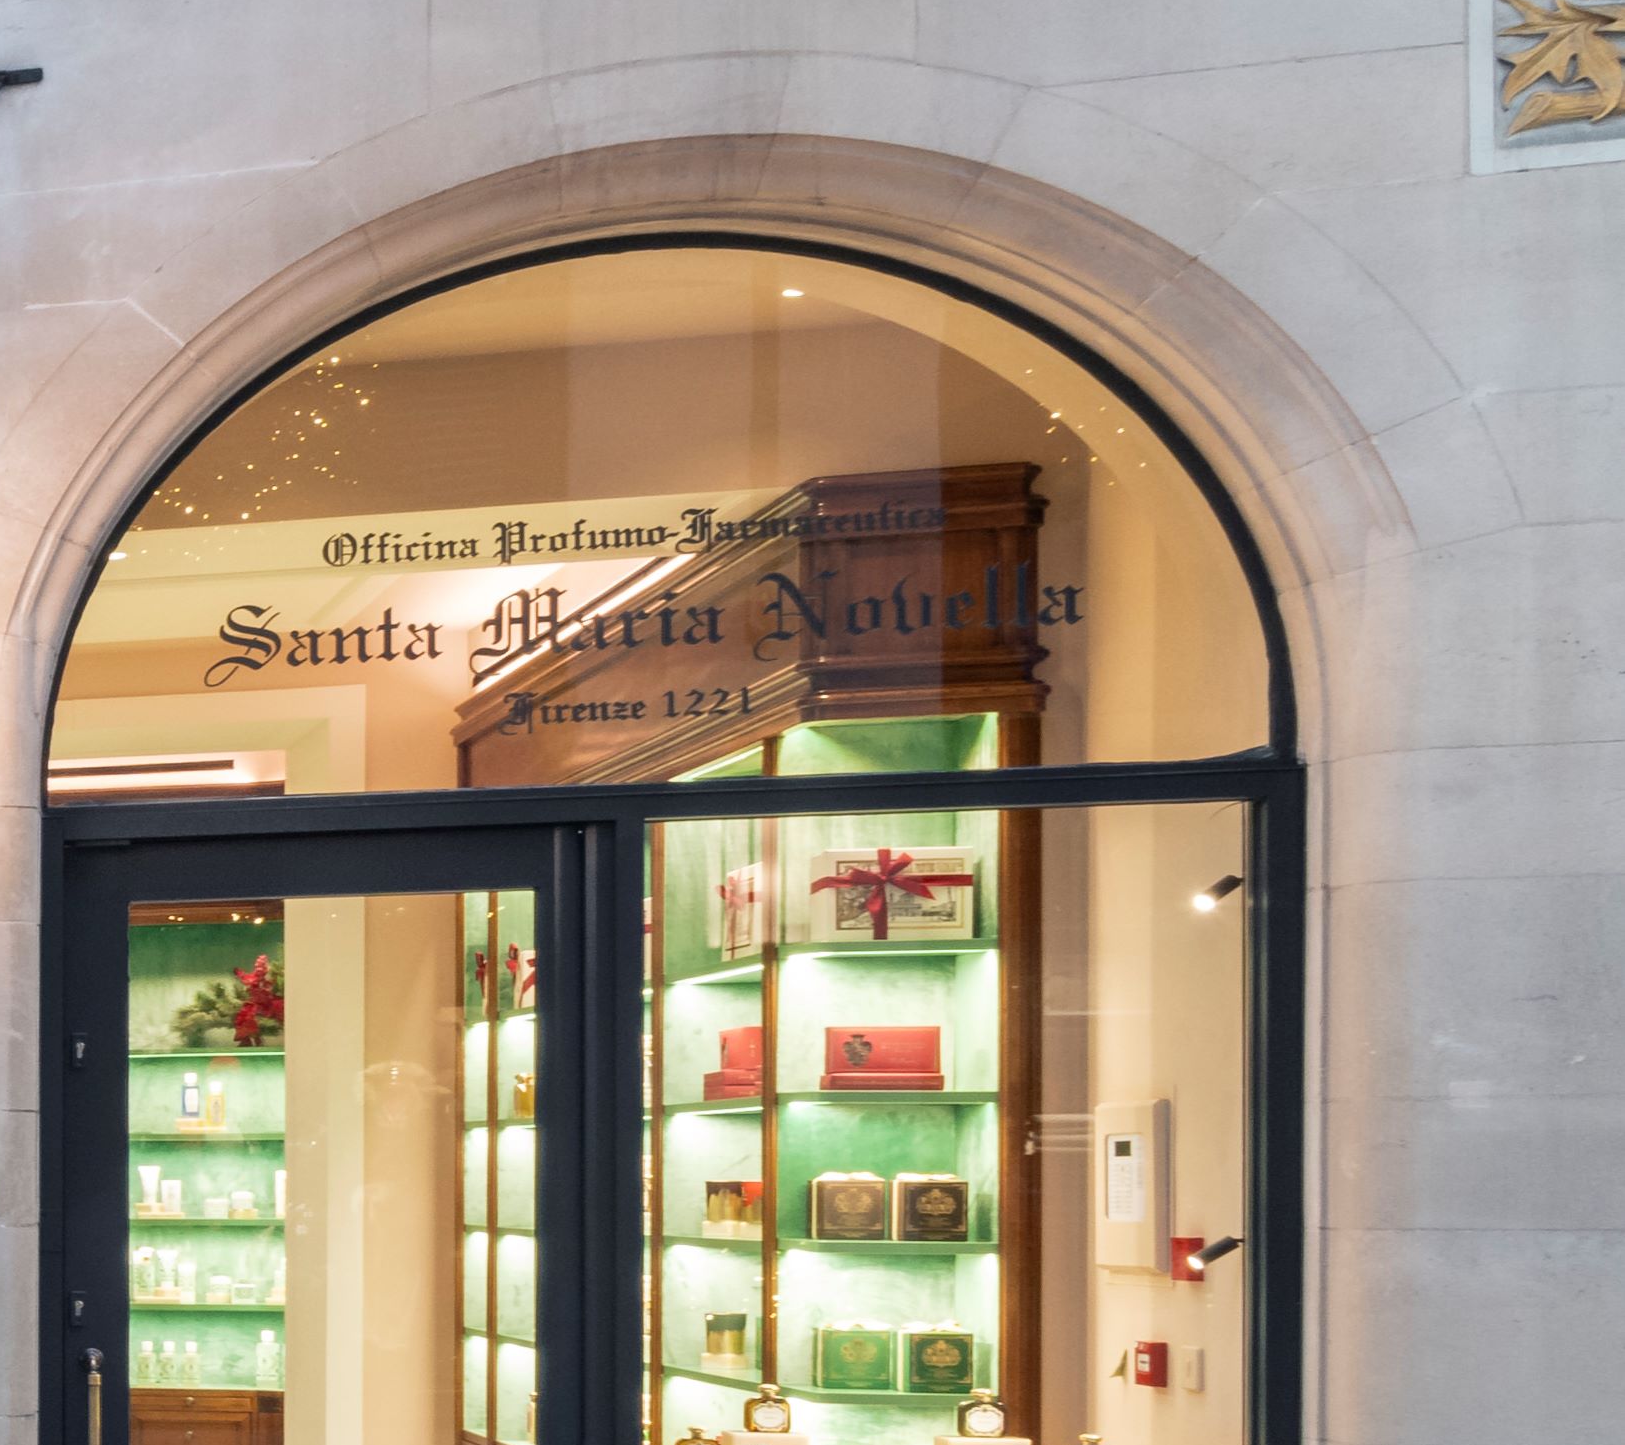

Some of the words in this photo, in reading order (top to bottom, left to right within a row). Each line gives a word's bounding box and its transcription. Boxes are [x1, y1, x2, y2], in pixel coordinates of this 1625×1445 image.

[322, 532, 479, 567] Officina
[204, 604, 444, 688] Santa
[469, 587, 725, 677] Maria
[753, 559, 1085, 662] Novella
[498, 691, 645, 735] Firenze
[663, 686, 753, 719] 1221
